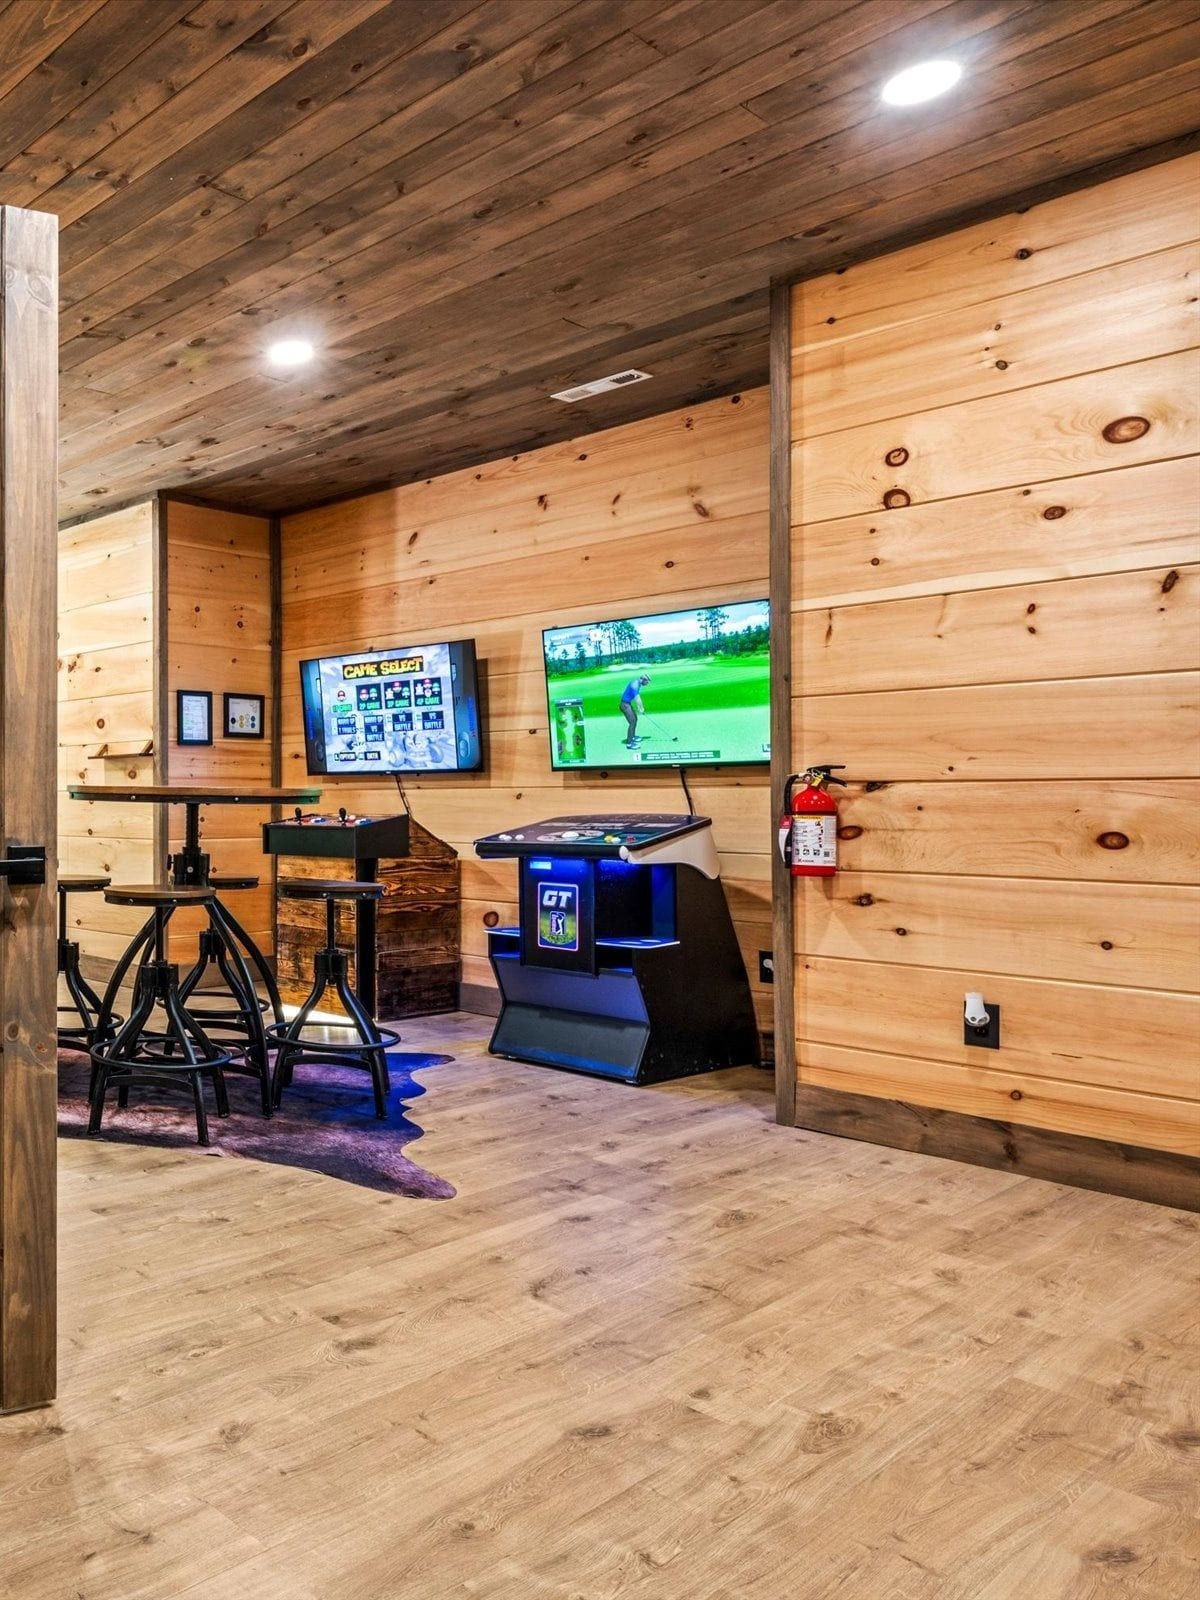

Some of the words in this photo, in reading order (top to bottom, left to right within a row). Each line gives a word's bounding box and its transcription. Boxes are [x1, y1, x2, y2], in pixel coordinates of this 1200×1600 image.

[343, 664, 378, 679] GAME
[380, 658, 422, 675] SELECT
[542, 890, 572, 908] GT
